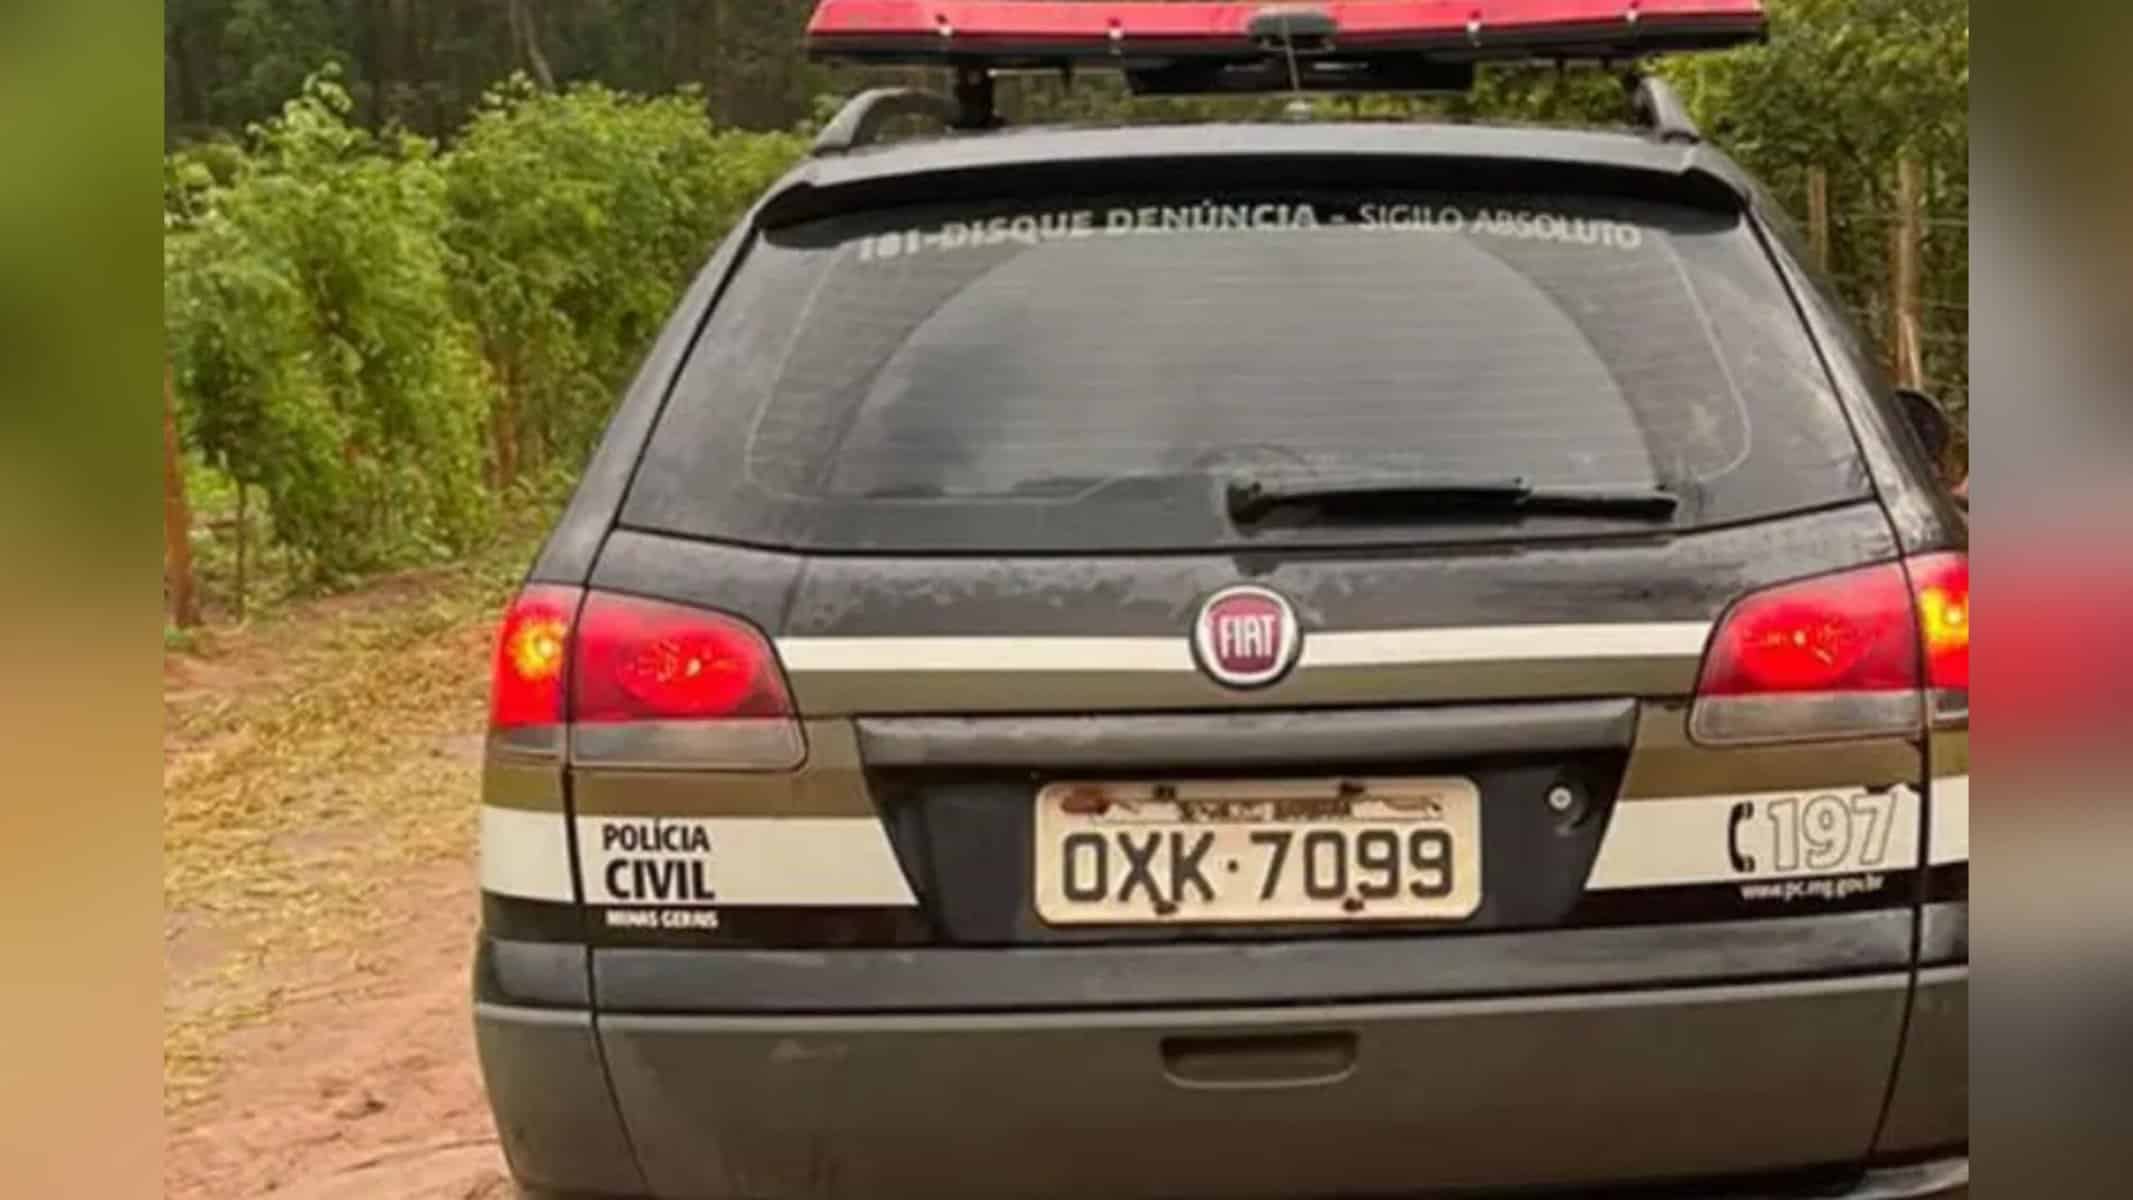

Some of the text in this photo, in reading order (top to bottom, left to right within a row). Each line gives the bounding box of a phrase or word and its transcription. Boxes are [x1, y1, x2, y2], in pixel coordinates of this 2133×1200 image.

[1106, 199, 1320, 232] DENÚNCIA
[1358, 203, 1466, 232] SIGILO
[1471, 207, 1642, 249] ABSOLUTO
[1219, 613, 1275, 658] FIAT
[602, 816, 710, 851] POLÍCIA
[1767, 792, 1898, 872] 197
[605, 858, 716, 900] CIVIL
[605, 909, 658, 927] MINAS
